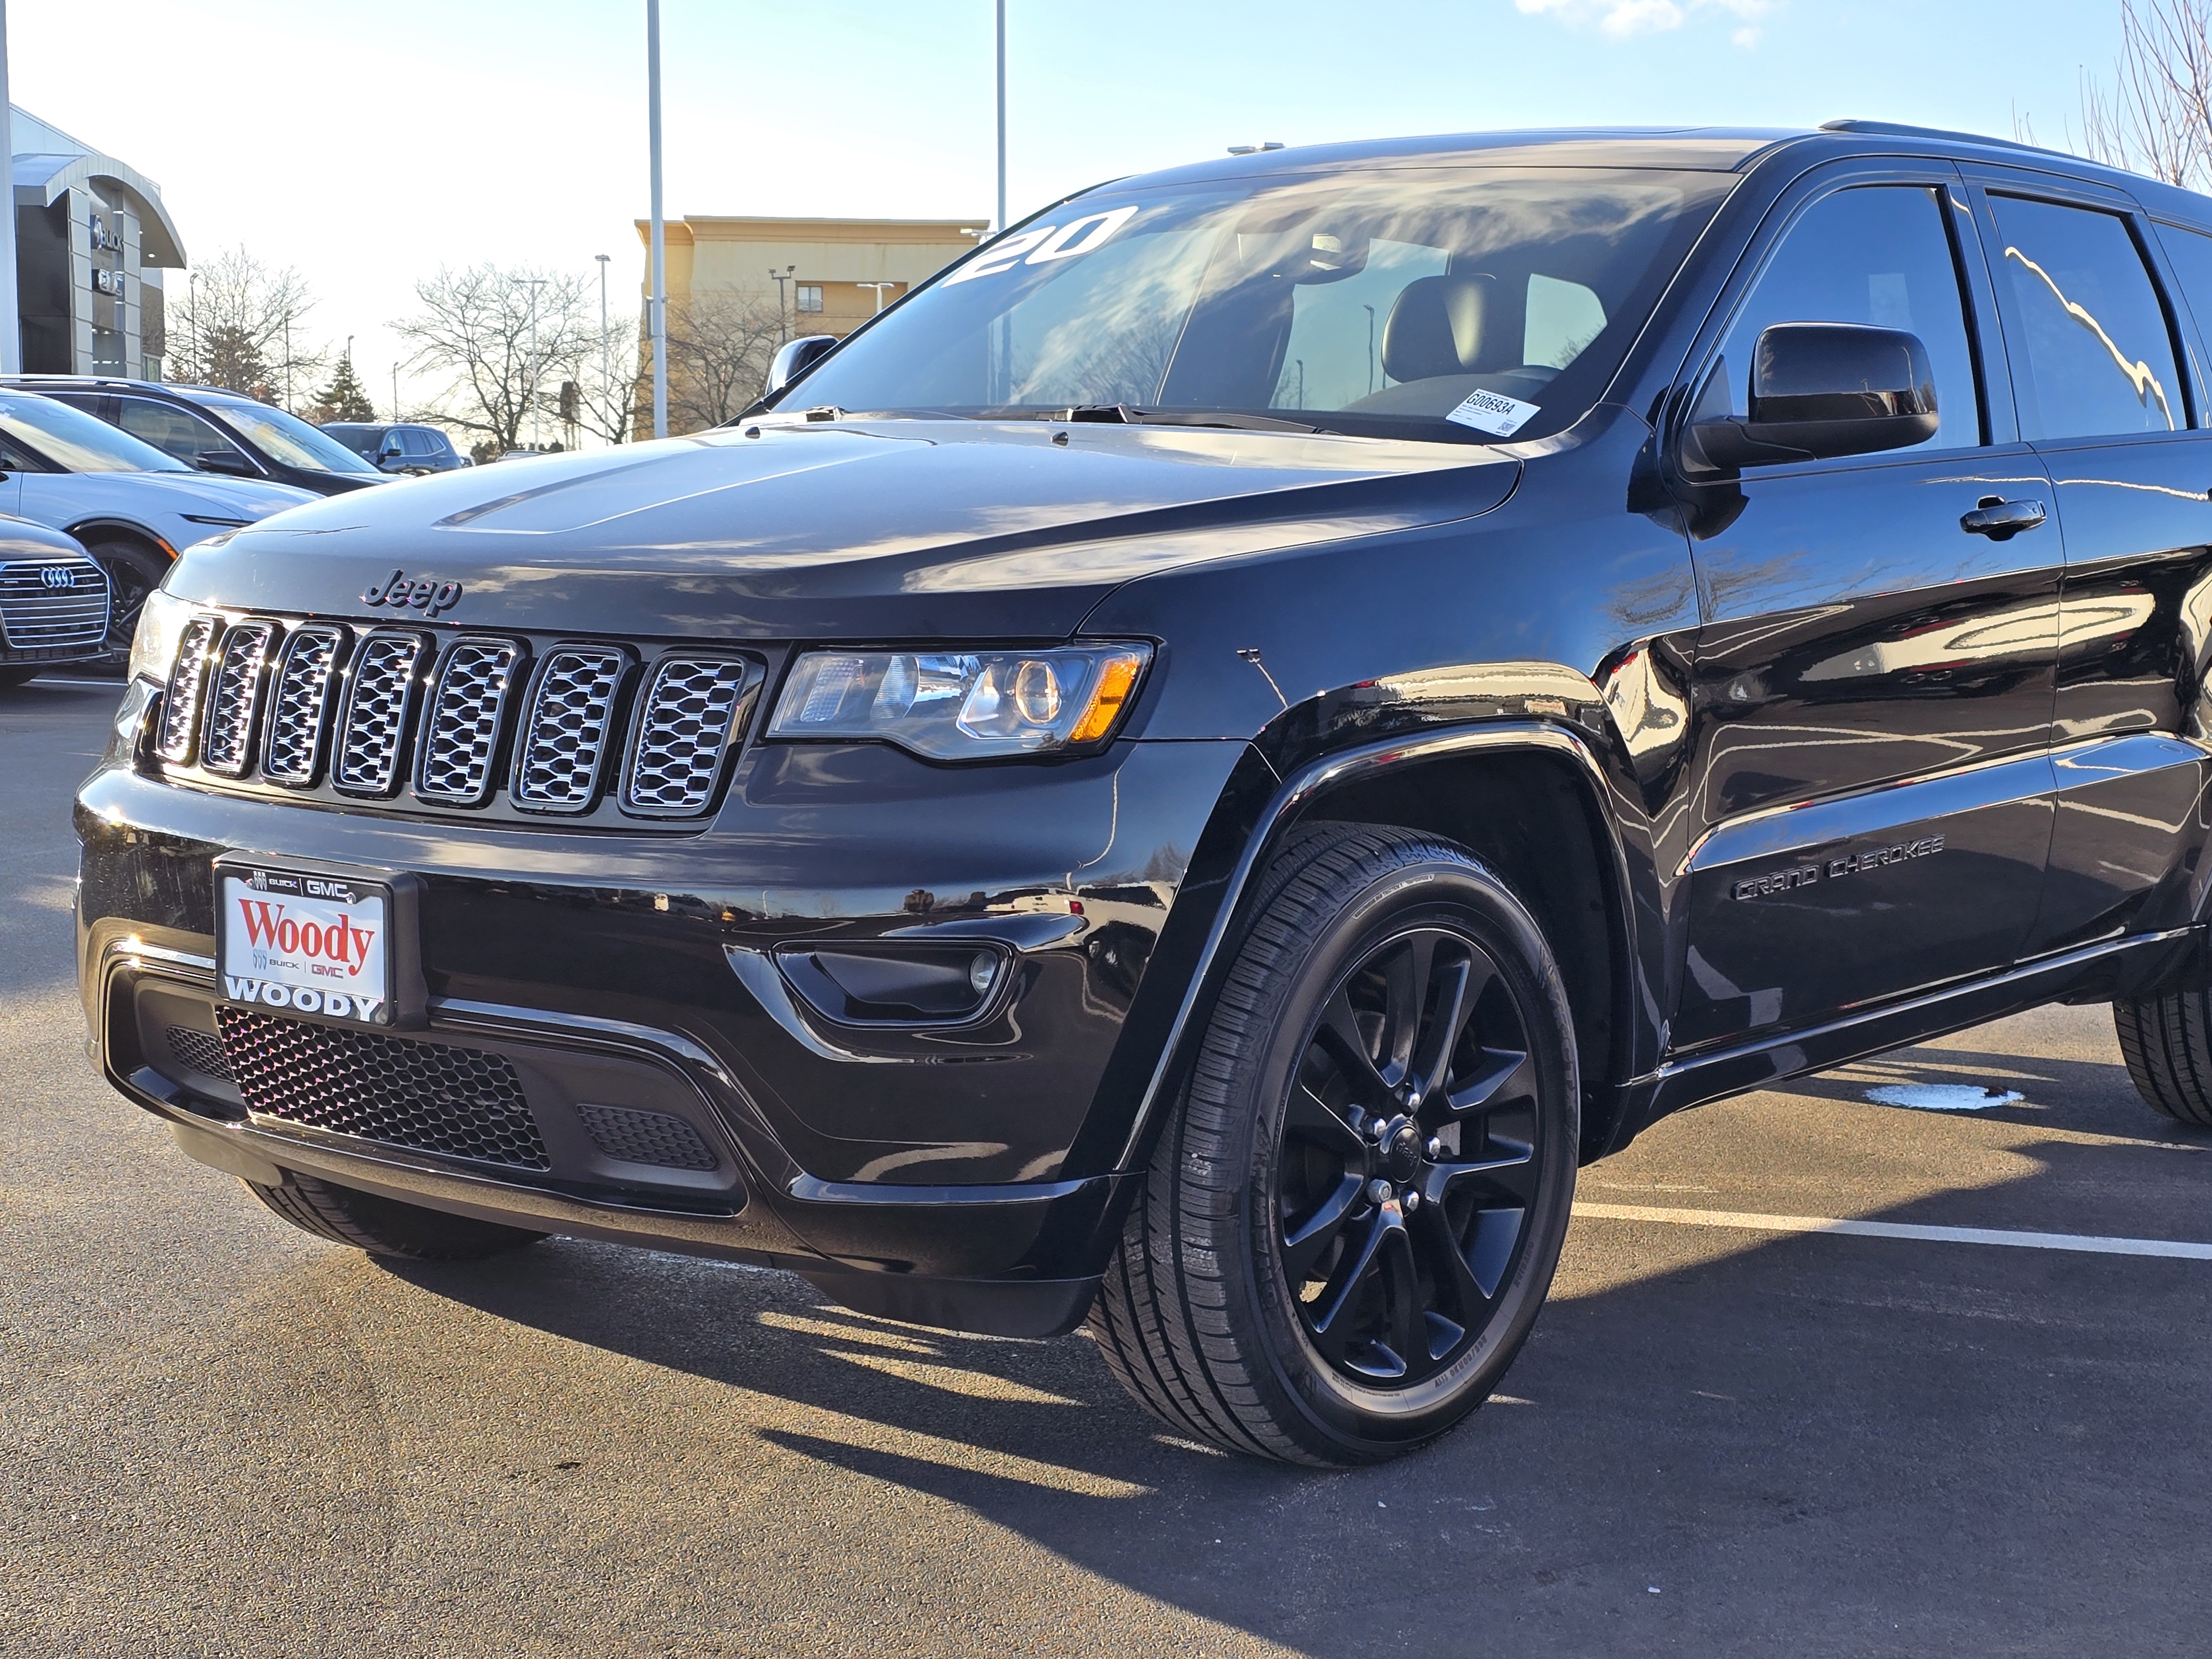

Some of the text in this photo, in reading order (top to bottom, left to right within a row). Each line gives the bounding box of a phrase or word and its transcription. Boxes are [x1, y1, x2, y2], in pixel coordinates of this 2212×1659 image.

[940, 206, 1139, 289] 20
[1466, 393, 1516, 415] G00693A
[359, 568, 463, 618] Jeep
[268, 878, 348, 898] BUICK GMC
[1730, 833, 1945, 900] GRAND CHEROKEE
[238, 898, 375, 977] Woody
[269, 959, 343, 979] BUICK GMC
[224, 975, 380, 1022] WOODY
